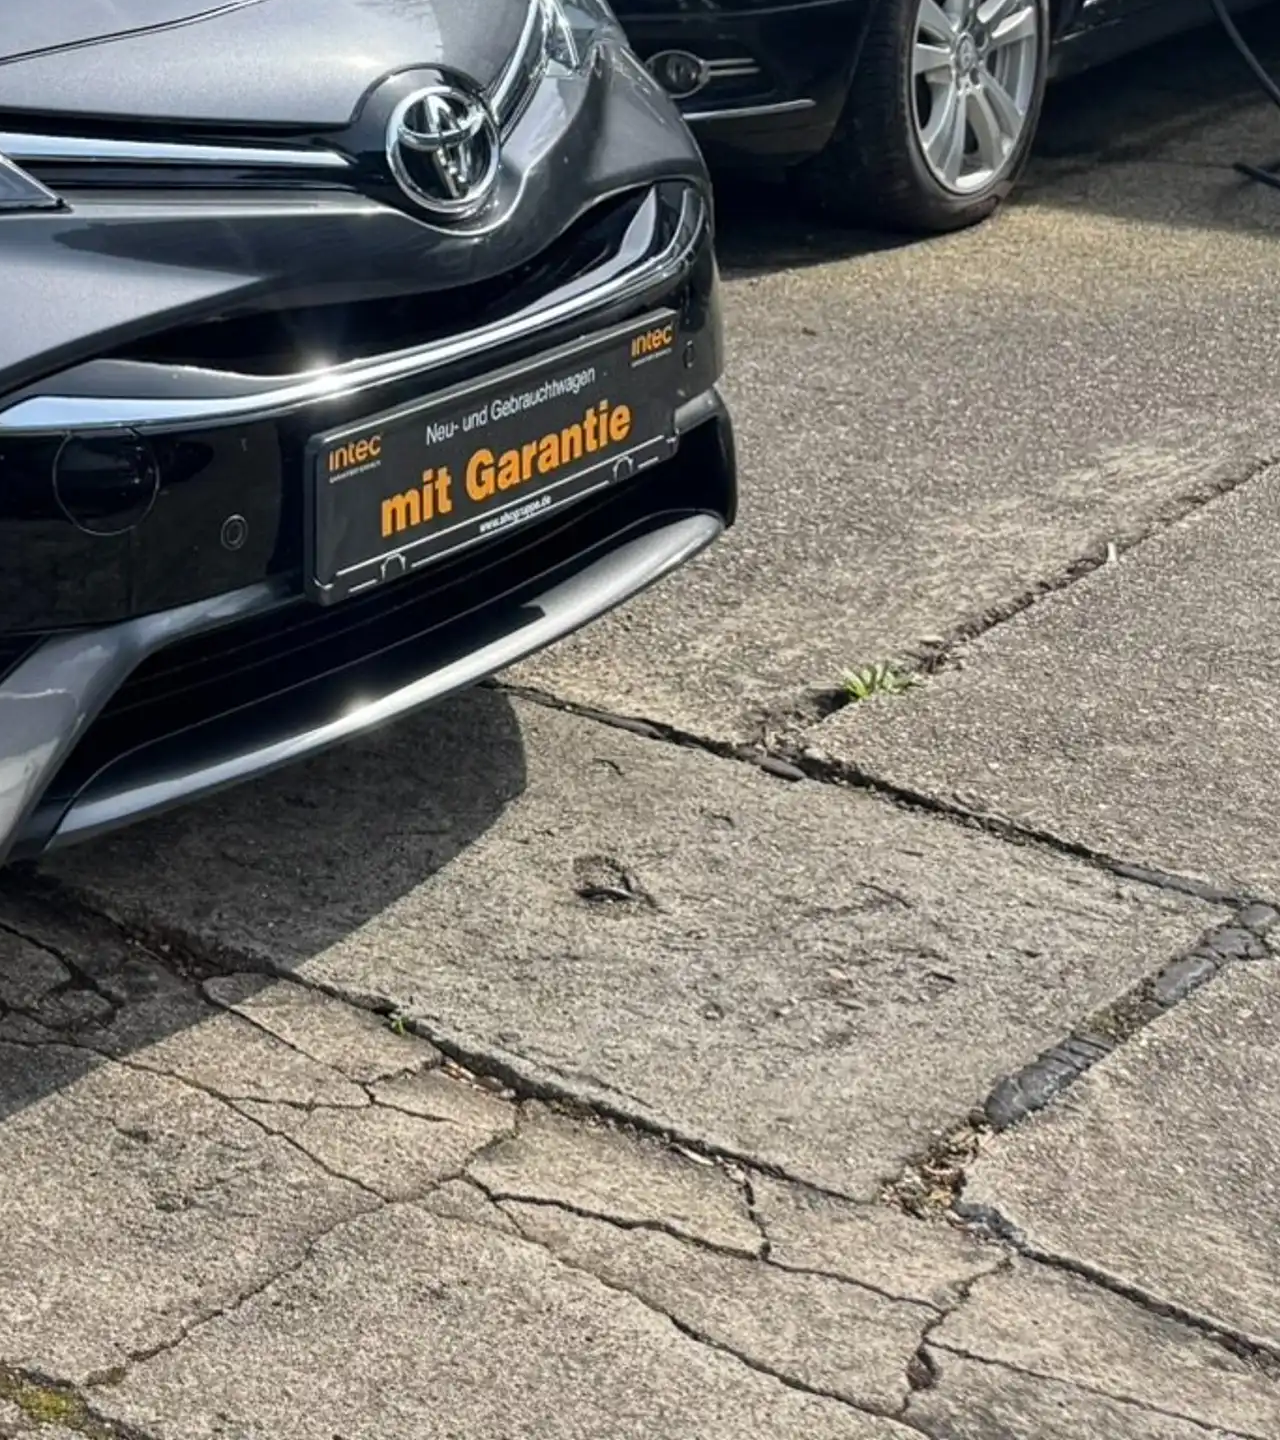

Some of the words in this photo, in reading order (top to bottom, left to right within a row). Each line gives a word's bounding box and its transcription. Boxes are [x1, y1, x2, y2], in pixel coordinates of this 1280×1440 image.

[425, 421, 459, 446] Neu-
[462, 404, 489, 432] und
[490, 367, 596, 421] Gebrauchtwagen
[380, 463, 453, 538] mit
[464, 399, 631, 502] Garantie
